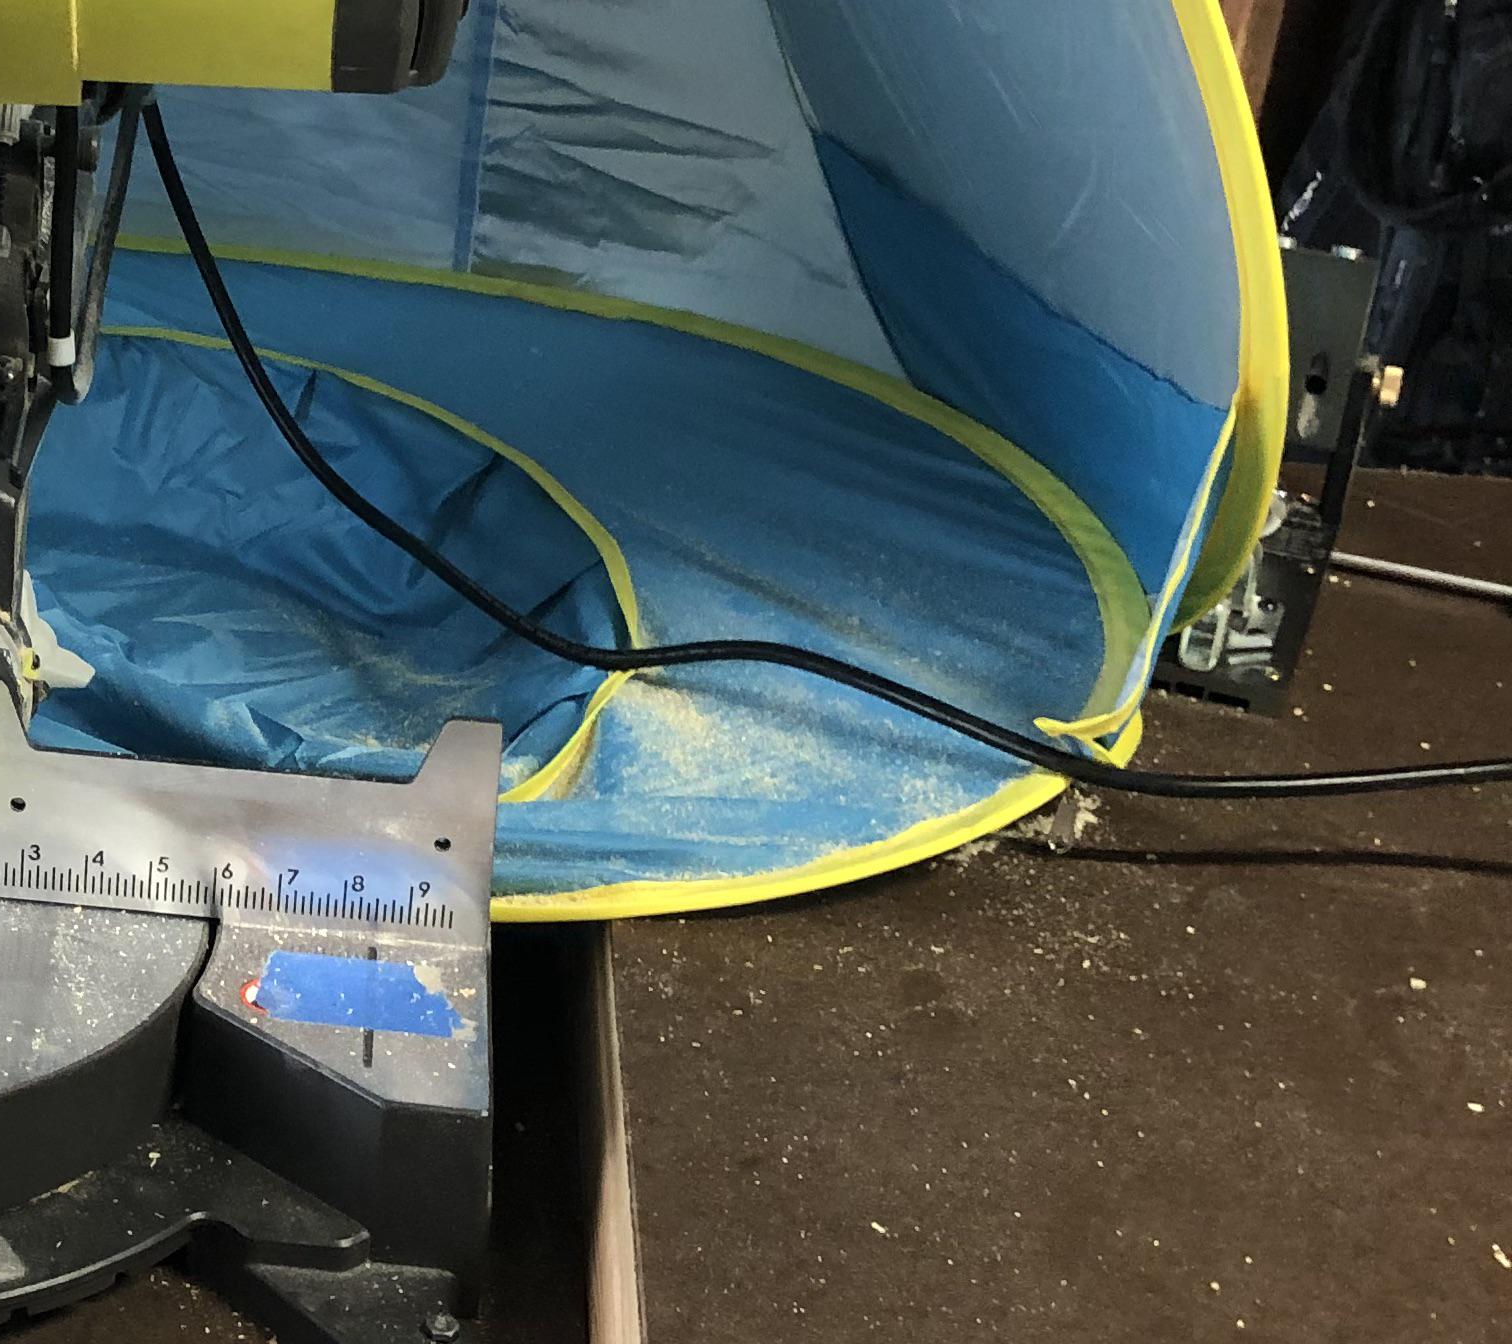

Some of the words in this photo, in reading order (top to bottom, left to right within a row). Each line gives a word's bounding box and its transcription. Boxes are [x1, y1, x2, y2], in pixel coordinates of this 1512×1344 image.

[27, 844, 41, 861] 3
[91, 850, 105, 867] 4
[156, 856, 169, 873] 5
[221, 862, 234, 880] 6
[286, 868, 300, 885] 7
[351, 875, 365, 893] 8
[418, 881, 431, 898] 9
